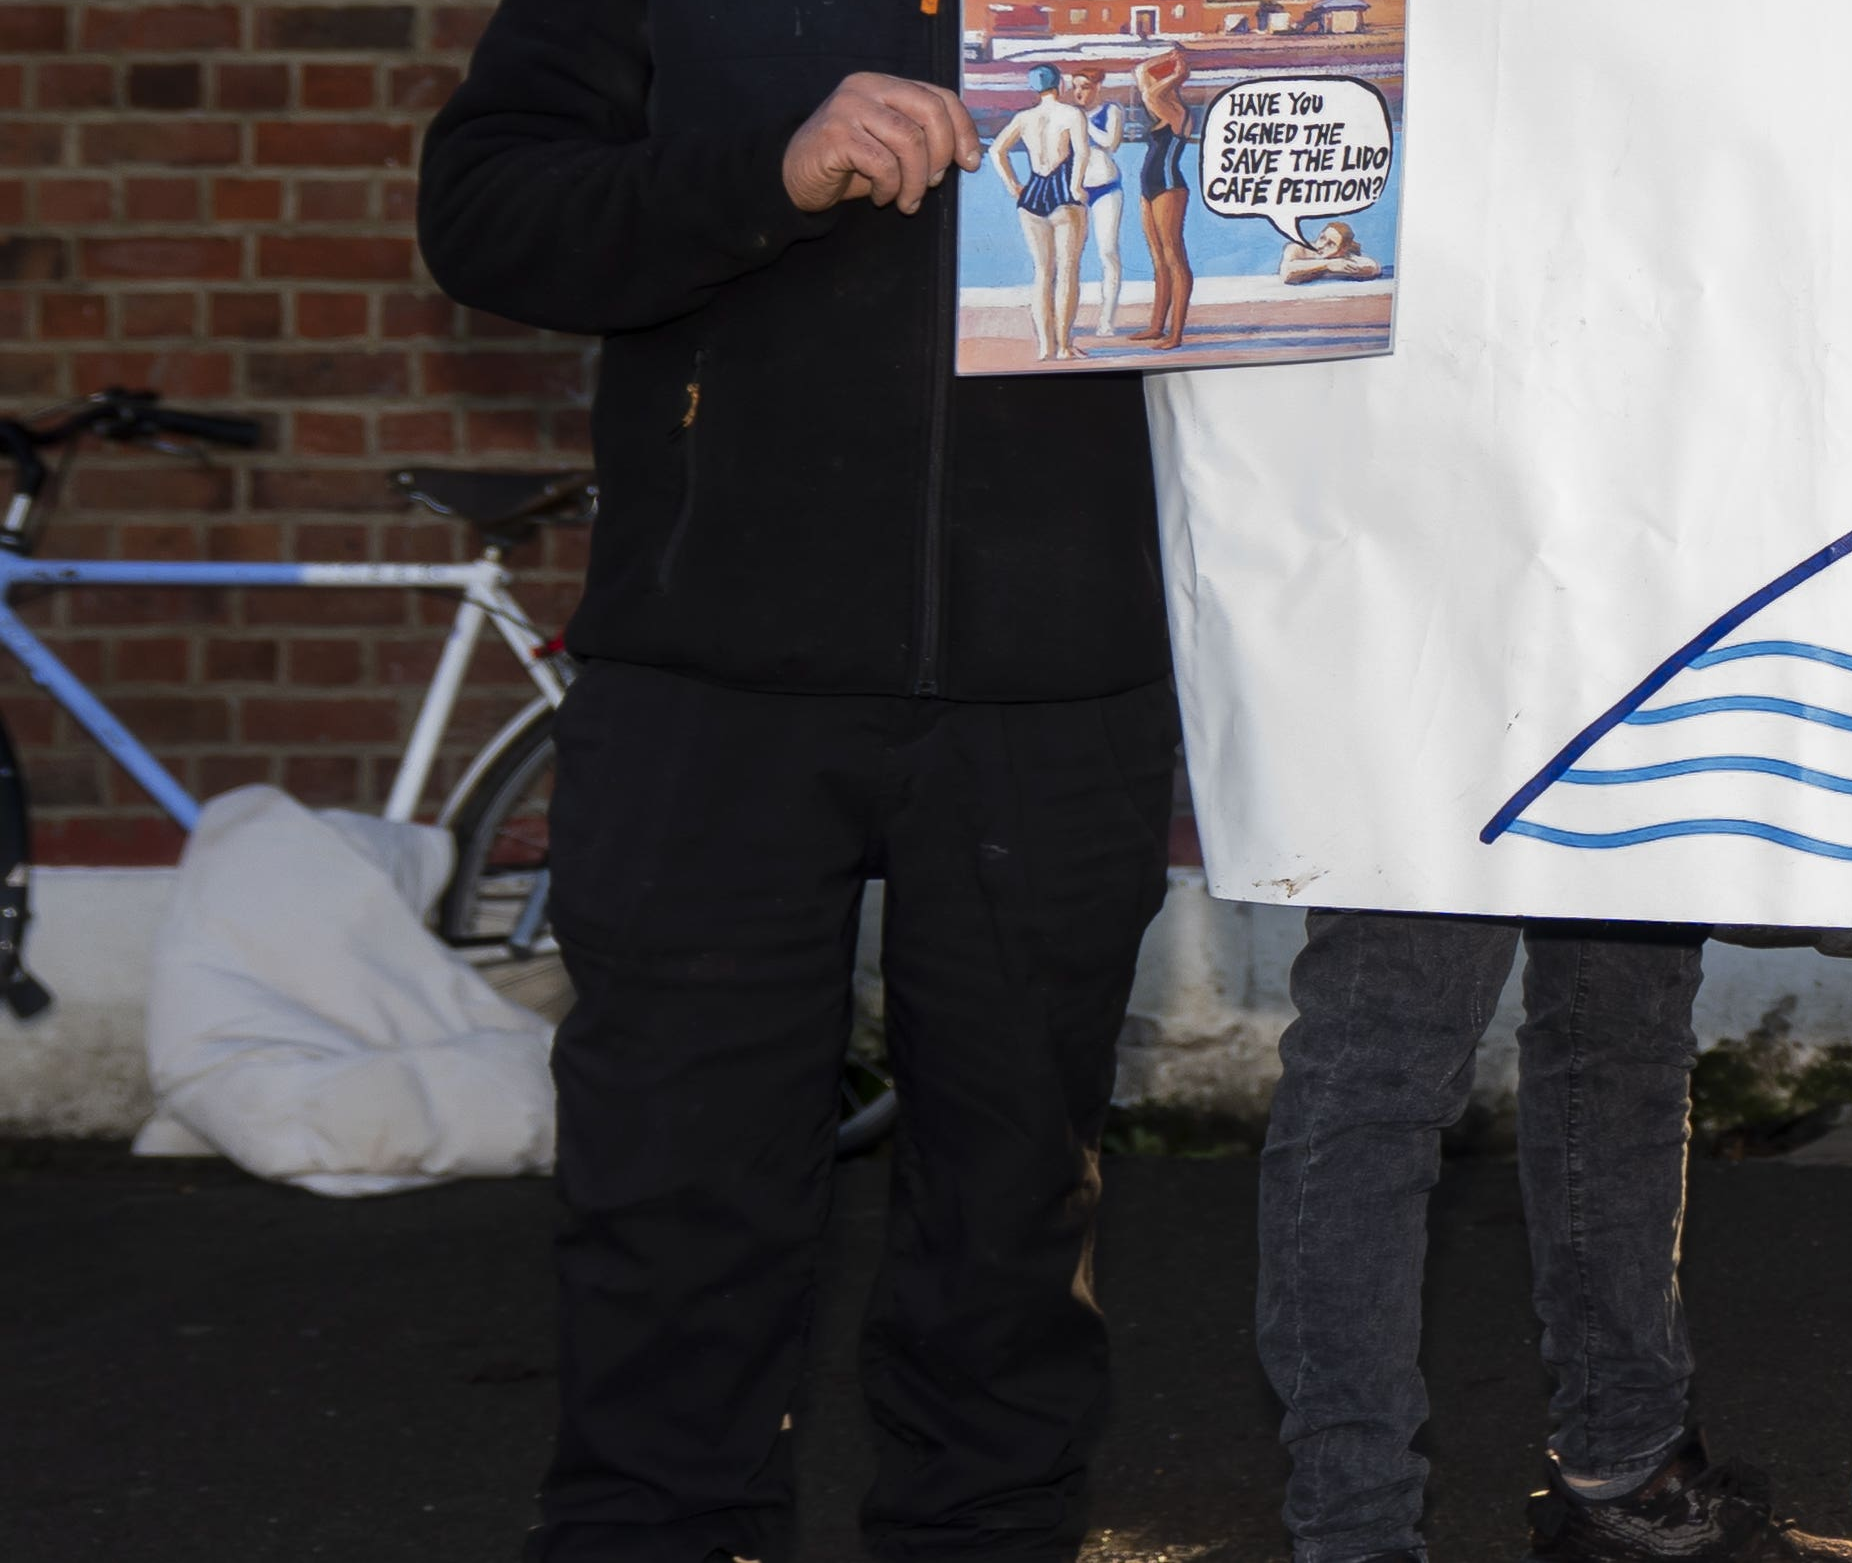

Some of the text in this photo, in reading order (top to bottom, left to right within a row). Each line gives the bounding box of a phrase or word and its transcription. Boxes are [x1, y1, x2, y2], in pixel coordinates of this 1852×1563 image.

[1229, 91, 1324, 117] HAVE YOU
[1223, 120, 1346, 146] SIGNED THE
[1220, 144, 1390, 175] SAVE THE LIDO
[1207, 174, 1384, 206] CAFÉ PETITION?
